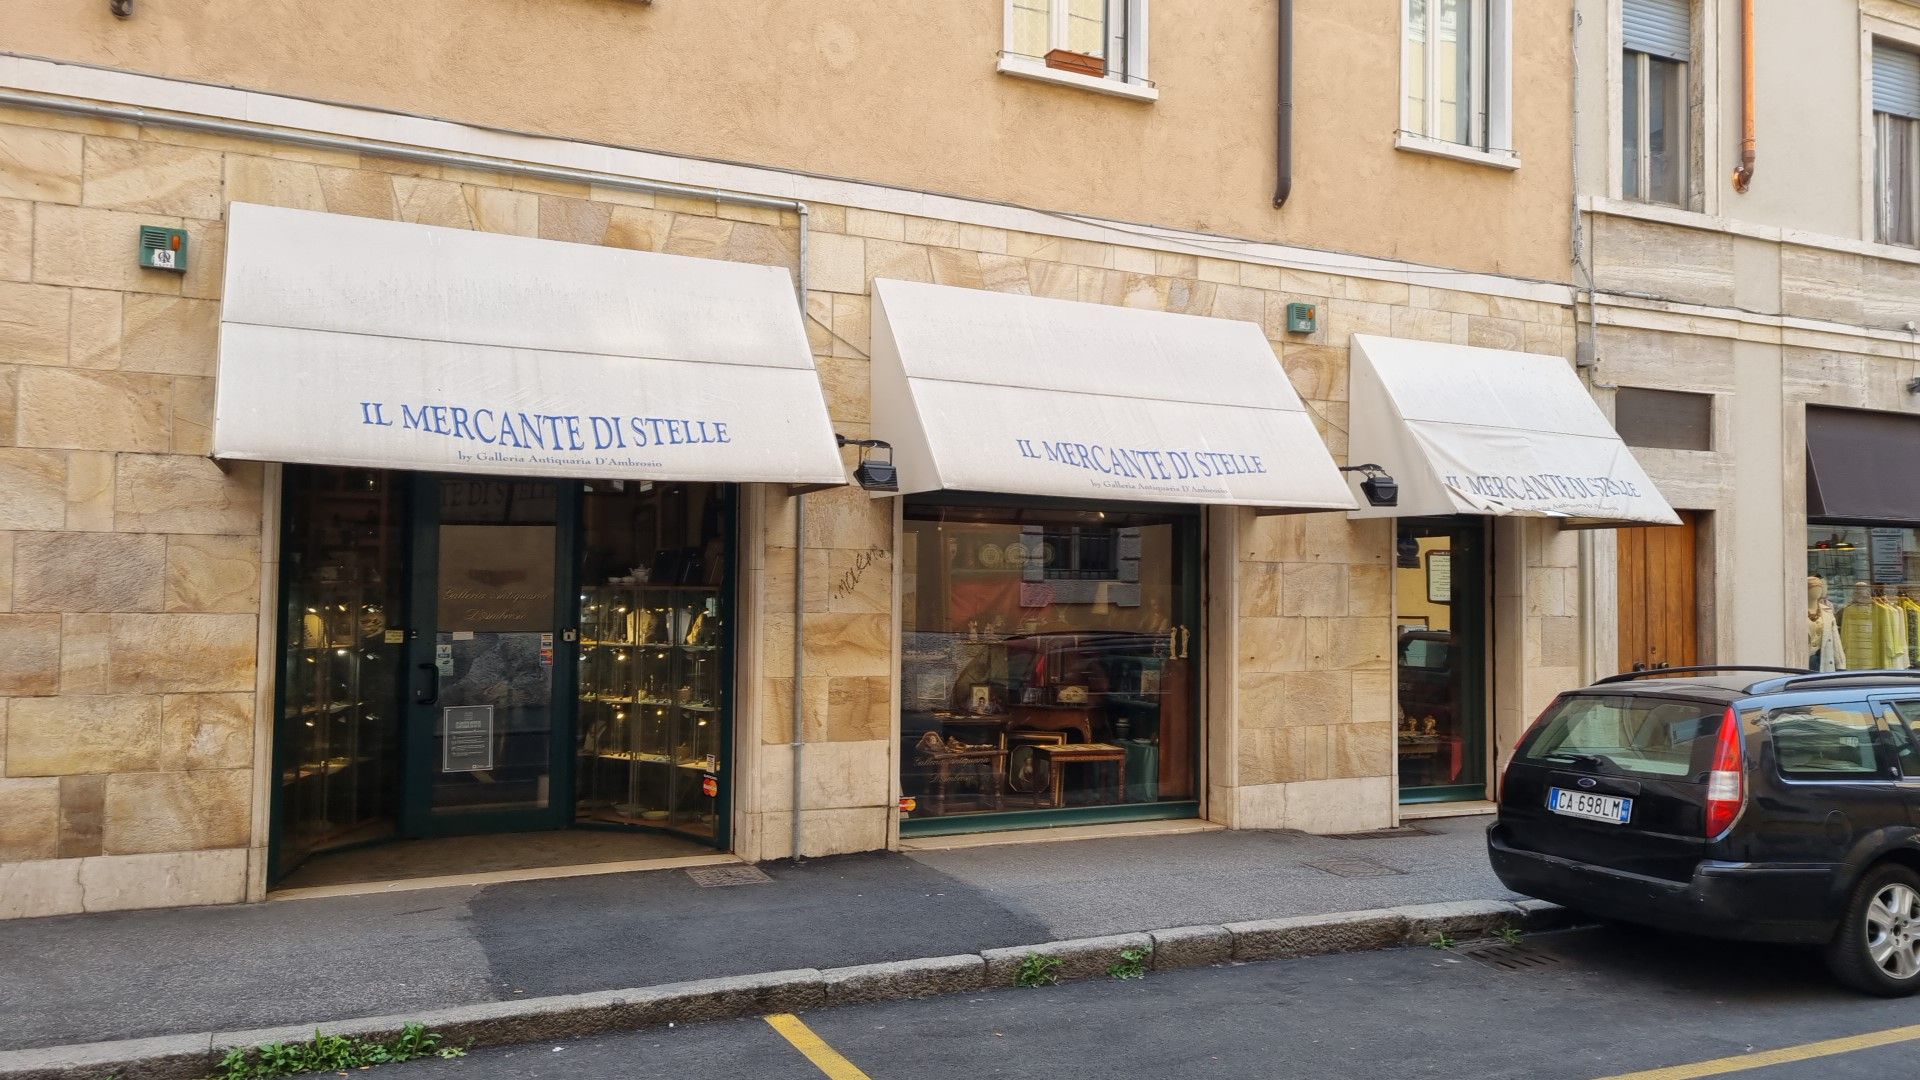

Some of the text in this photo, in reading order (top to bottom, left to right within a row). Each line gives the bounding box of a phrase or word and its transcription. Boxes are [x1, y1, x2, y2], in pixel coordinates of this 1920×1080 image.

[360, 402, 732, 451] IL MERCANTE DI STELLE
[458, 451, 663, 468] by Galleria Antiquaria D'Ambrosio
[1016, 439, 1267, 480] IL MERCANTE DI STELLE
[1466, 474, 1575, 501] MERCANTE
[1566, 477, 1596, 499] DI
[1559, 792, 1620, 818] CA 698LM
